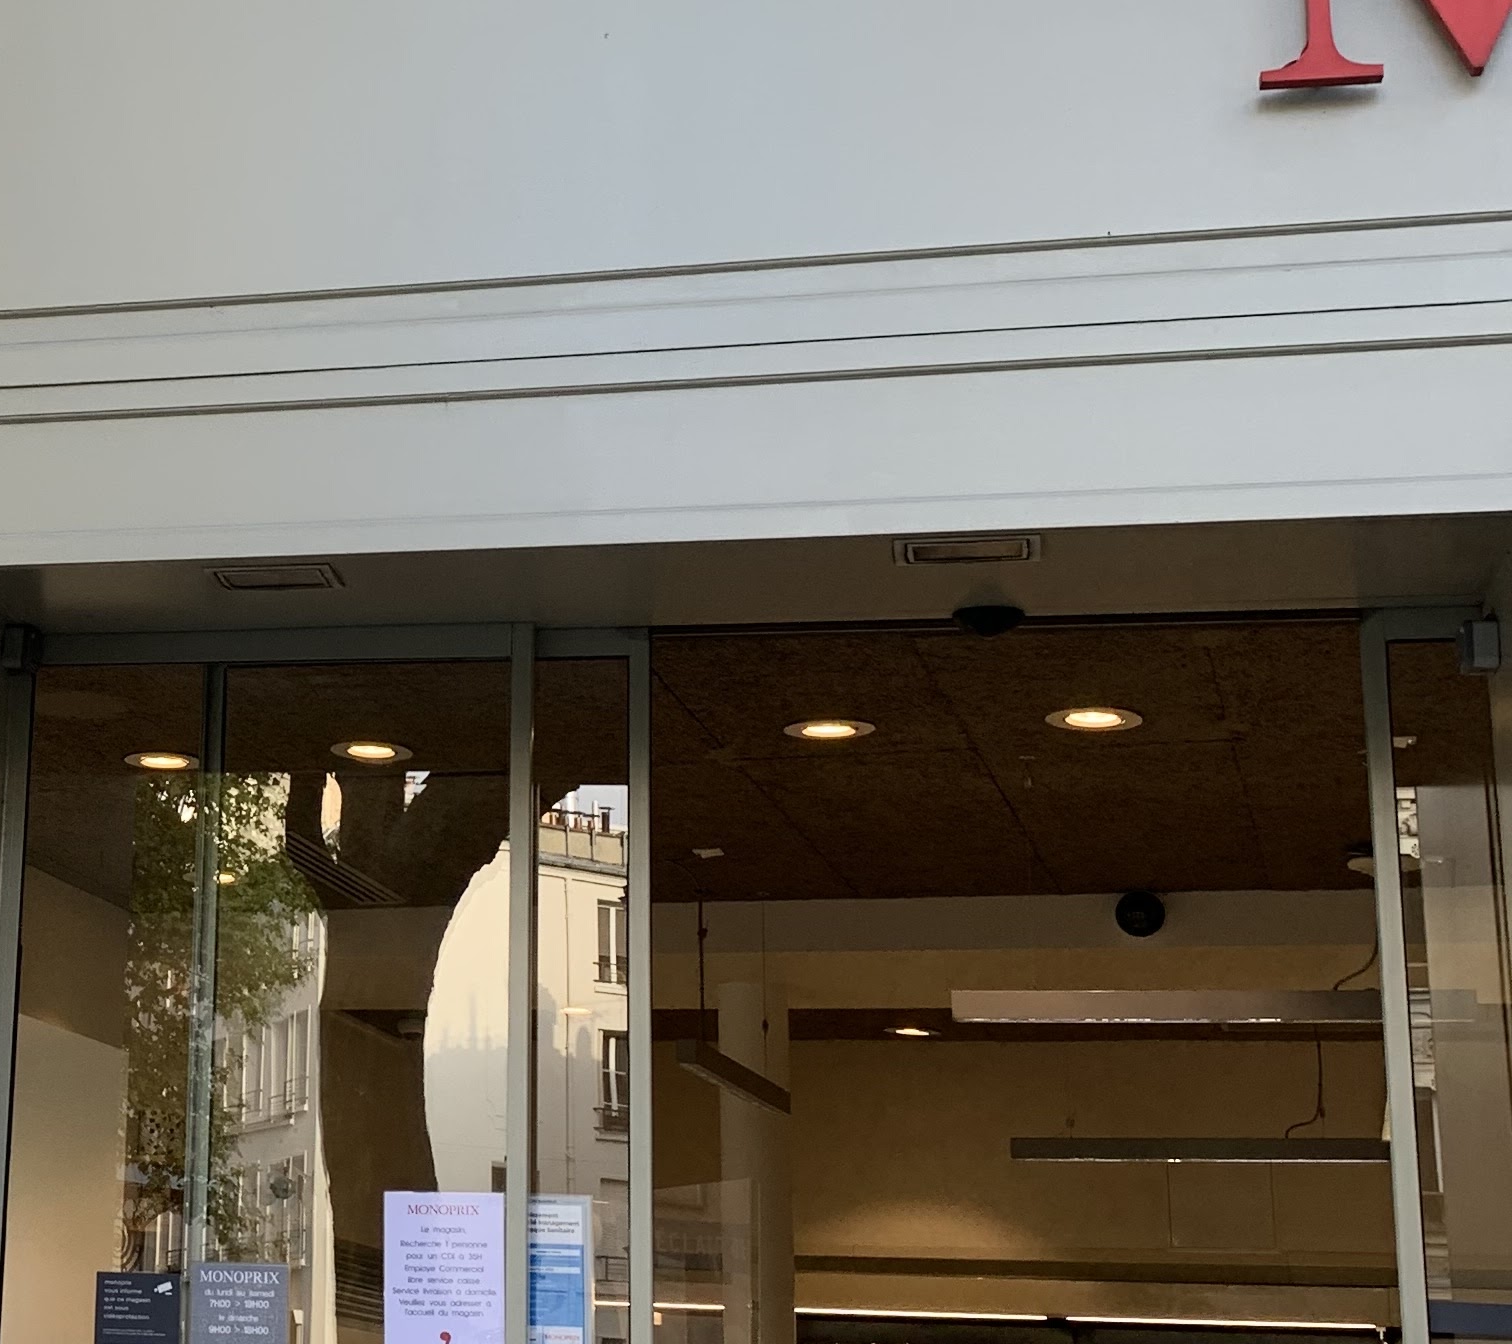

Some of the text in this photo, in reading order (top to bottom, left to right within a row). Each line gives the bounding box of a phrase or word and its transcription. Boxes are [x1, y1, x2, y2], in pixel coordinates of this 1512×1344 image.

[407, 1204, 479, 1215] MONOPRIX
[420, 1225, 430, 1233] Le
[399, 1239, 441, 1248] Recherche
[451, 1241, 488, 1250] personne
[405, 1253, 424, 1261] pour
[439, 1264, 484, 1273] Commercial
[200, 1269, 280, 1285] MONOPRIX
[204, 1288, 215, 1296] du
[216, 1288, 234, 1296] lundi
[248, 1289, 275, 1297] samedi
[392, 1287, 420, 1295] Service
[398, 1298, 425, 1307] Veuillez
[450, 1299, 482, 1307] adresser
[208, 1324, 232, 1334] 9H00
